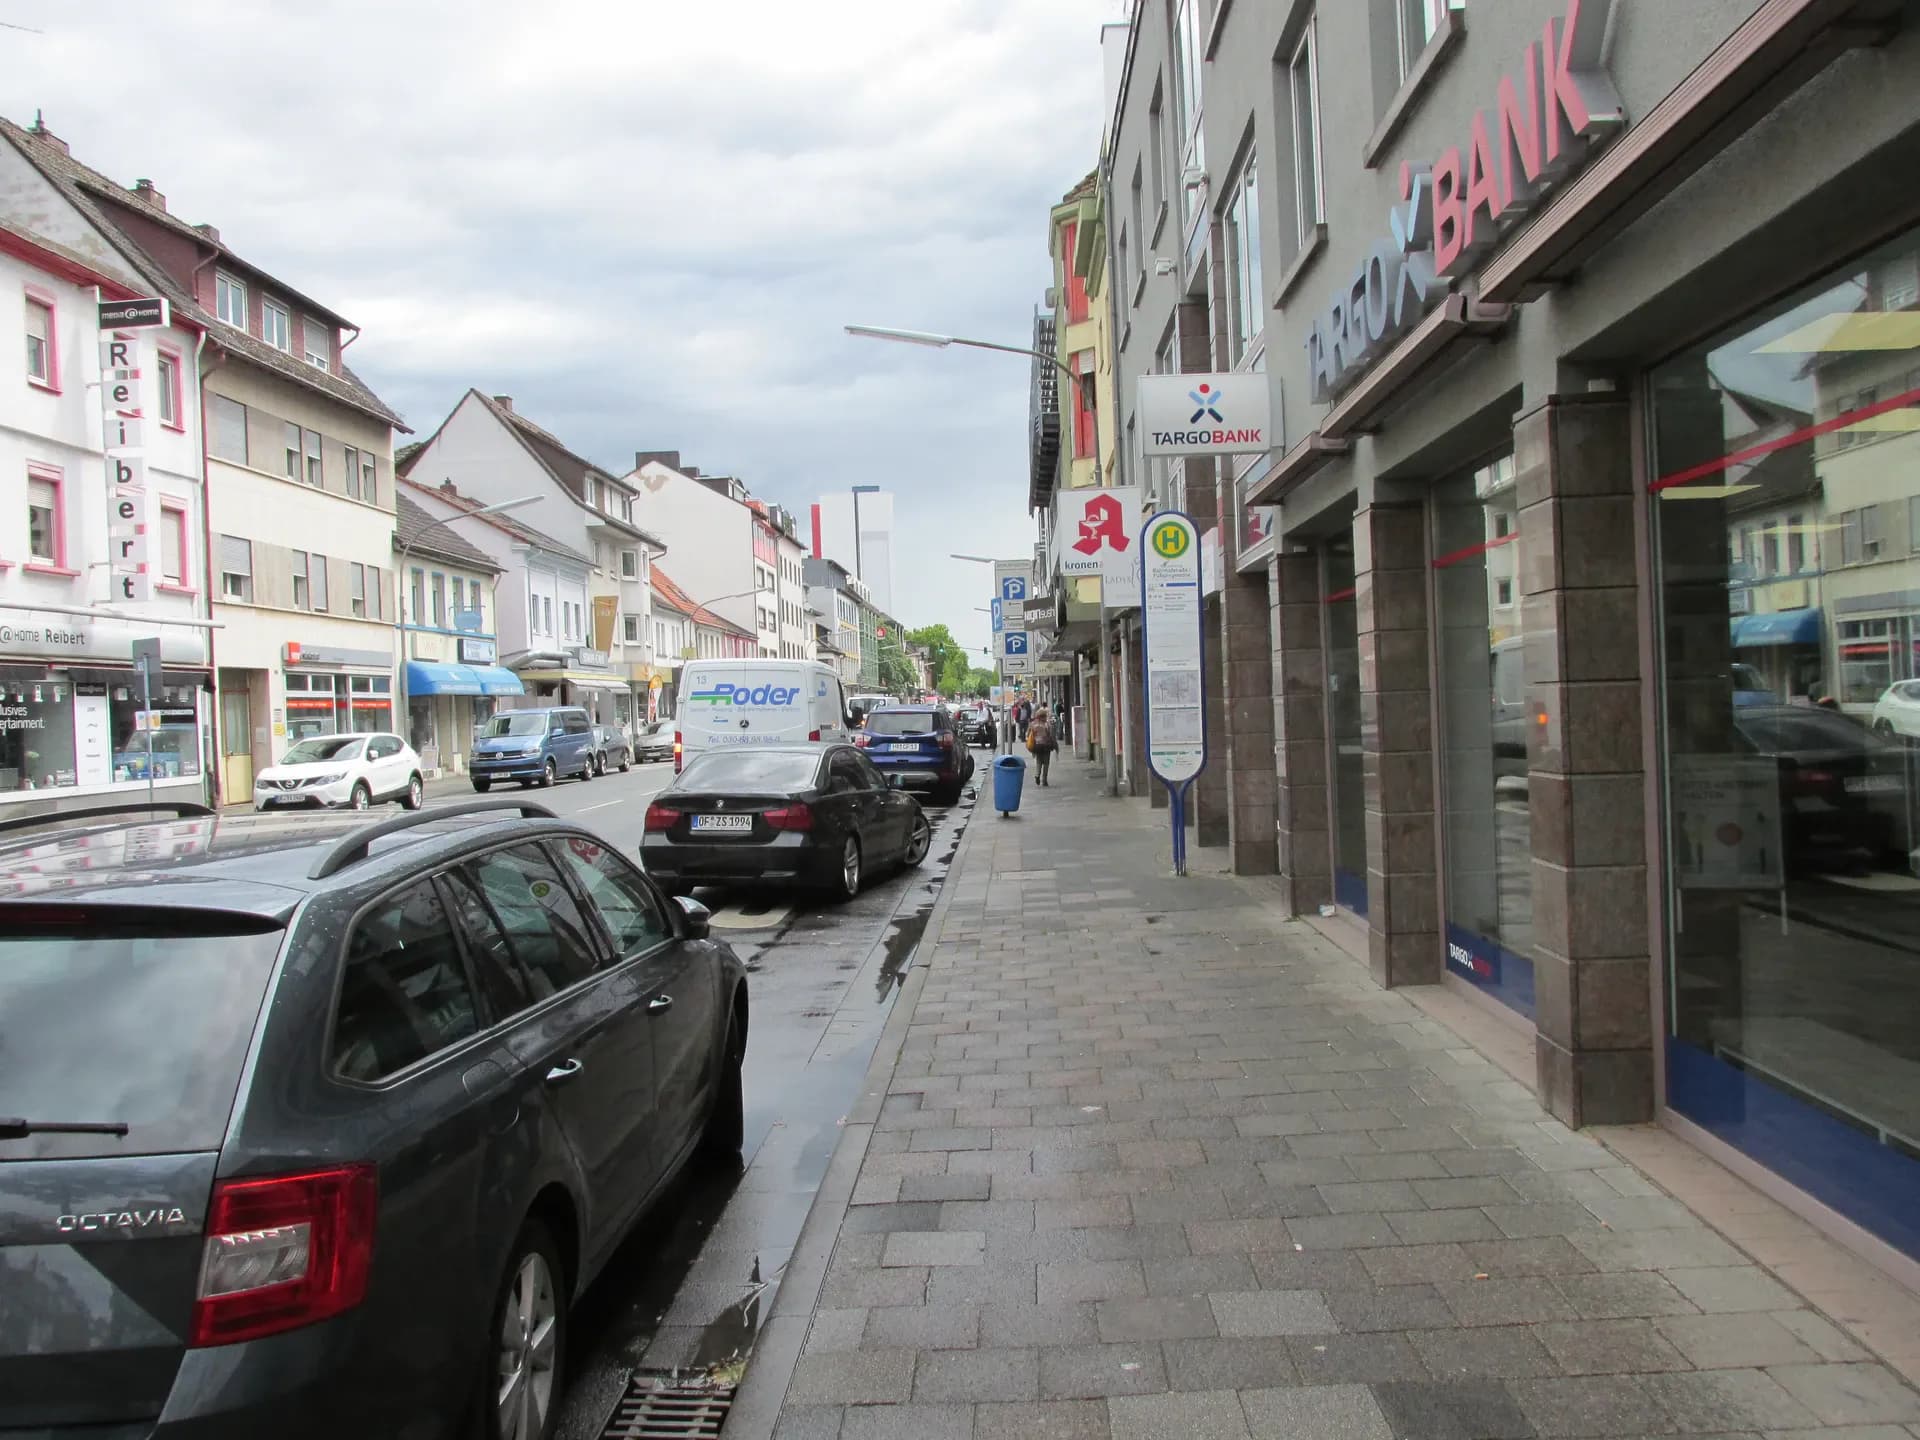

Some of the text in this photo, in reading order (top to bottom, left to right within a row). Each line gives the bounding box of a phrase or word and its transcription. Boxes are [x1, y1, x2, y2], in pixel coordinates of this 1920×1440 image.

[1304, 0, 1590, 392] TARGO BANK
[1151, 428, 1262, 446] TARGOBANK
[110, 342, 134, 599] Reibert
[45, 628, 85, 646] Reibert
[696, 675, 708, 685] 13
[699, 816, 751, 827] OF ZS 1994
[56, 1207, 185, 1232] OCTAVIA
